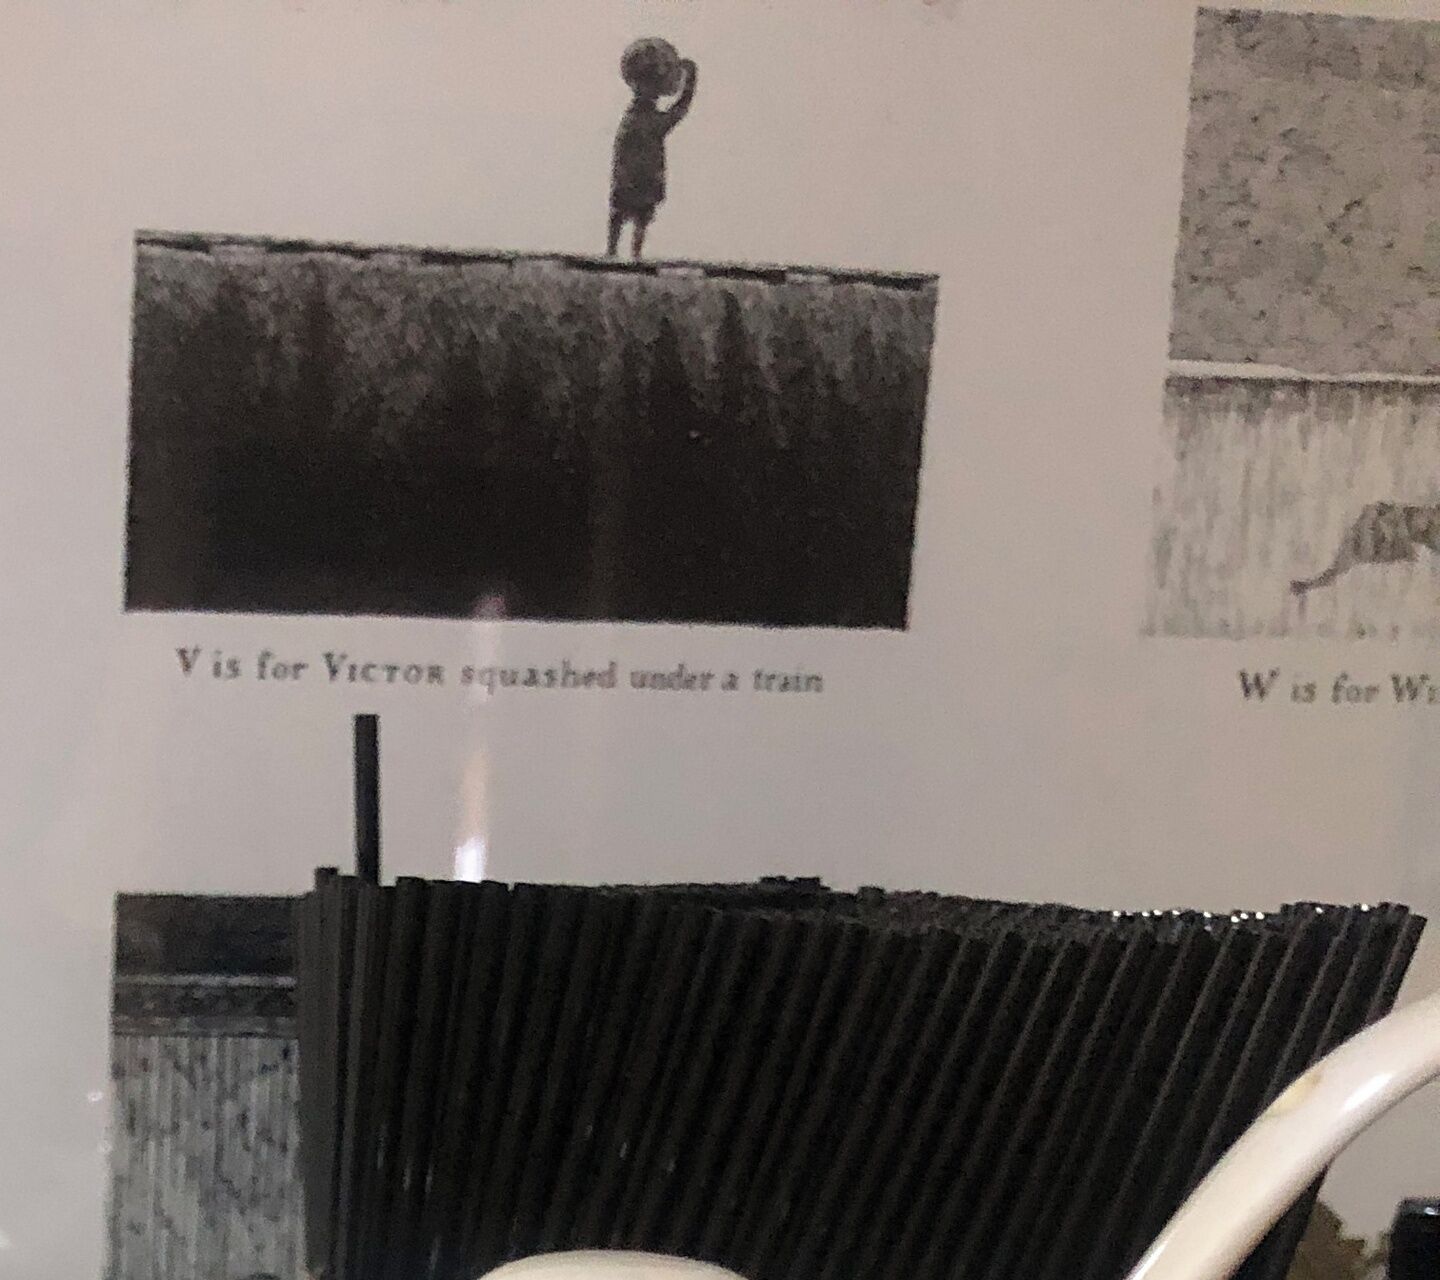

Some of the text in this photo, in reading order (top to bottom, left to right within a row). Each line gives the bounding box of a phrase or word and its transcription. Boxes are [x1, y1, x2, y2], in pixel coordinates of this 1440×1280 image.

[175, 647, 202, 677] V
[212, 648, 241, 680] is
[257, 650, 308, 681] for
[461, 660, 618, 696] squashed
[630, 662, 715, 692] under
[721, 671, 740, 693] a
[752, 665, 824, 693] train
[1238, 668, 1280, 701] W
[1289, 672, 1316, 704] is
[1330, 671, 1380, 704] for
